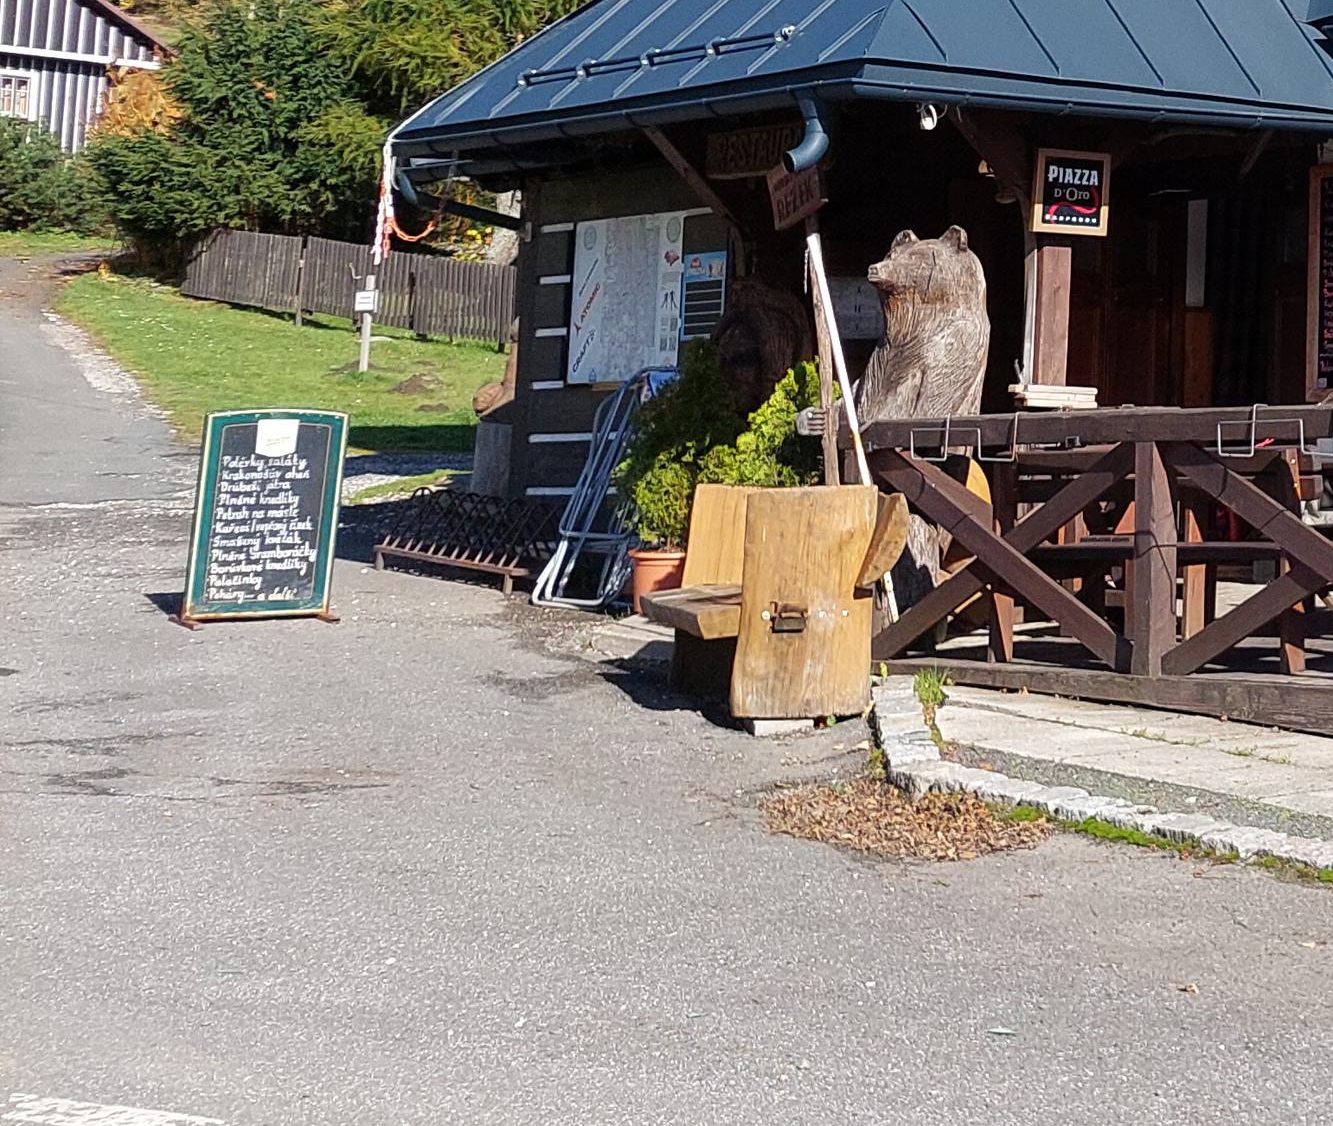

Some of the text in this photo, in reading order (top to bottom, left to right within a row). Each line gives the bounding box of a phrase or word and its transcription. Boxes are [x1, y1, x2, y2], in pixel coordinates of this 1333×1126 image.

[1047, 165, 1098, 186] PIAZZA
[1054, 187, 1090, 201] D'Oro
[580, 282, 600, 323] ATOMIC
[573, 336, 590, 372] CRAFT
